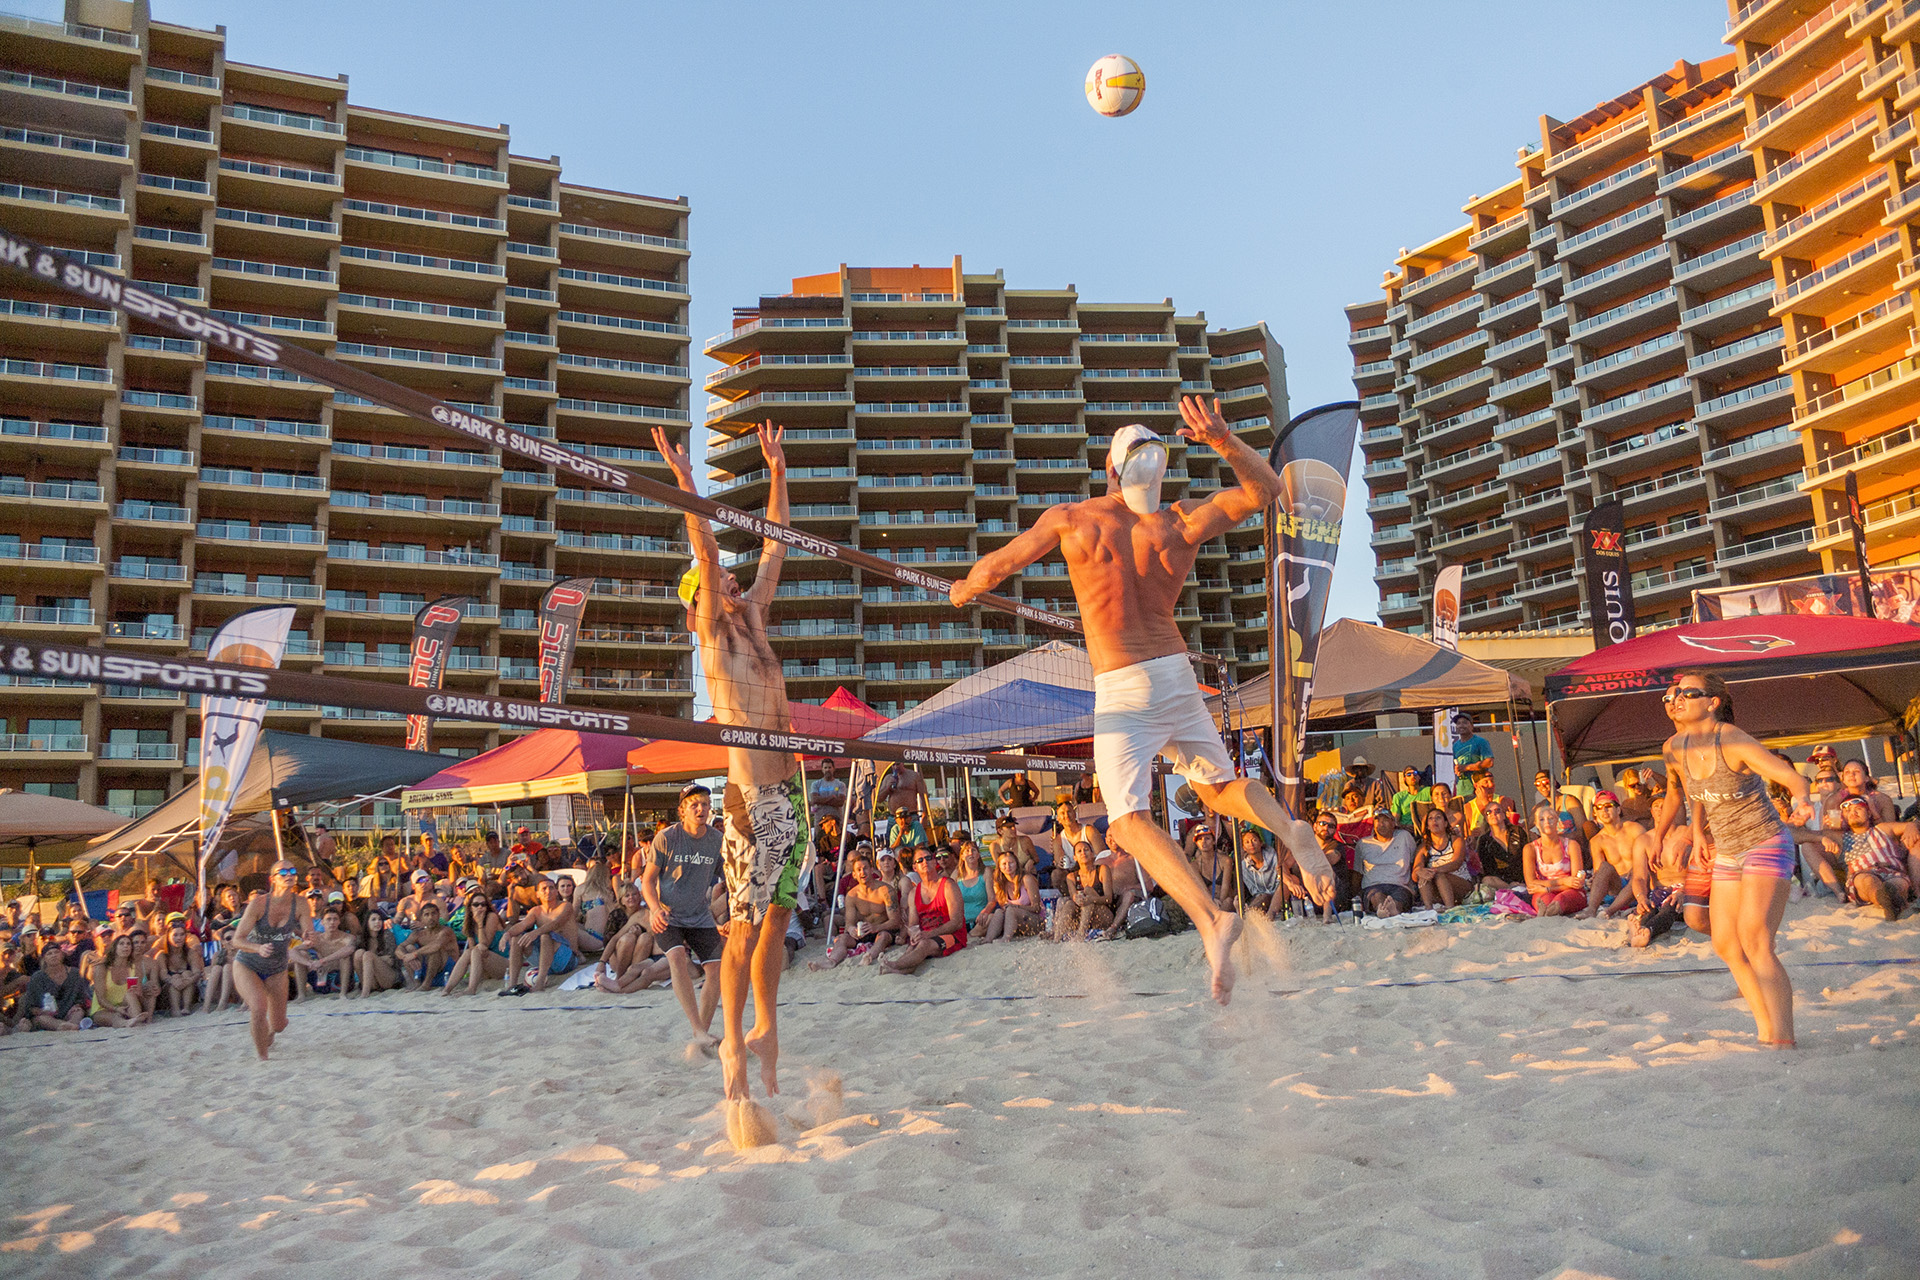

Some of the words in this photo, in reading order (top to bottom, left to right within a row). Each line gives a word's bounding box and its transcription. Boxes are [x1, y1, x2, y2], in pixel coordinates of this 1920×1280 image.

[37, 254, 58, 278] &
[450, 411, 492, 440] PARK
[495, 428, 507, 445] &
[728, 512, 753, 532] PARK
[754, 520, 762, 533] &
[902, 569, 920, 584] PARK
[920, 575, 926, 586] &
[1021, 606, 1034, 619] PARK
[1602, 570, 1630, 644] QUIS
[11, 647, 34, 671] &
[1560, 673, 1685, 695] CARDINALS
[1584, 667, 1660, 684] ARIZONA
[446, 696, 489, 717] PARK
[492, 701, 504, 718] &
[732, 730, 758, 745] PARK
[760, 734, 767, 746] &
[911, 750, 928, 761] PARK
[929, 751, 935, 762] &
[1031, 759, 1045, 769] PARK
[674, 852, 715, 865] ELEVATED
